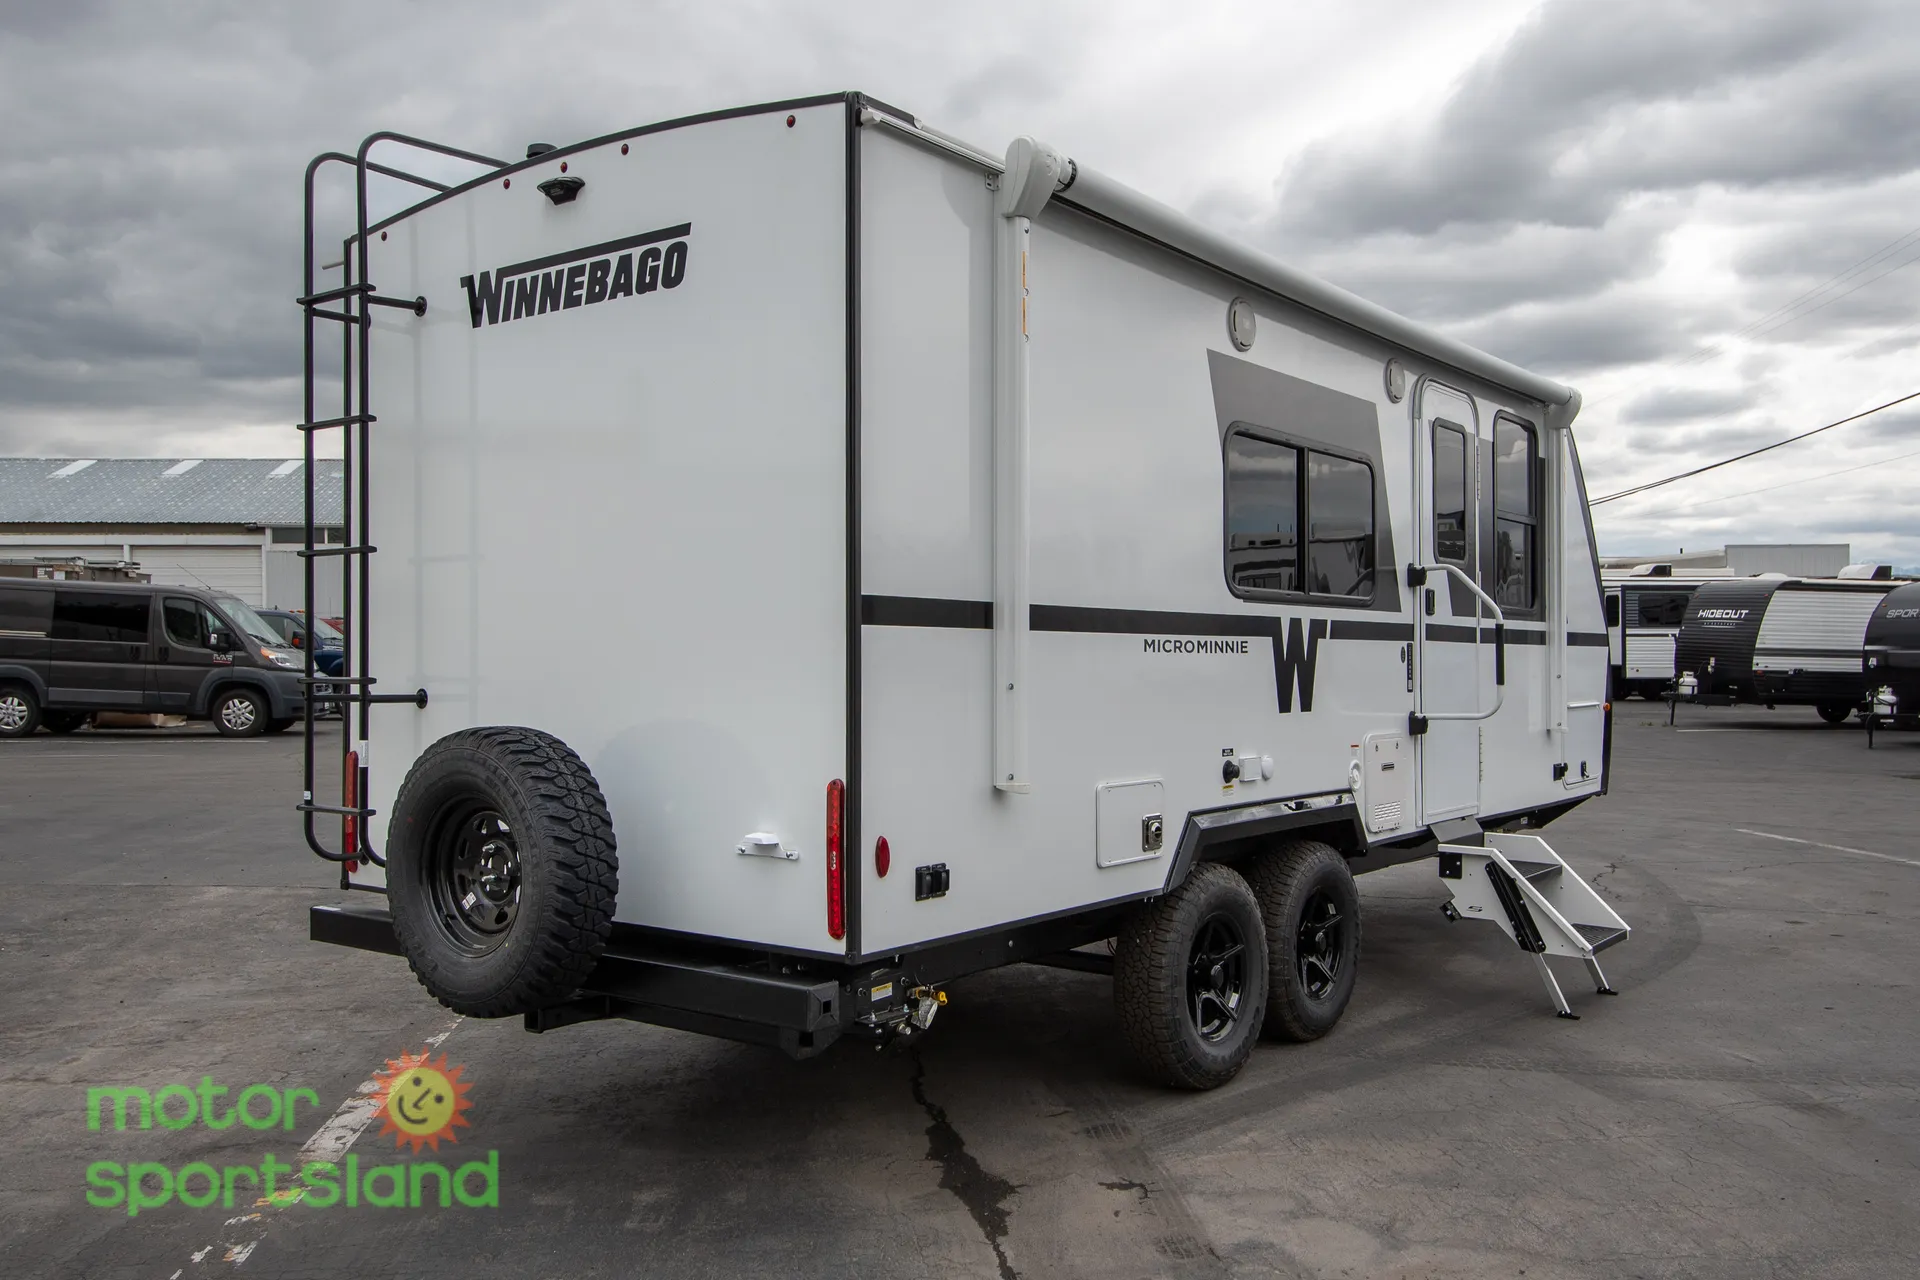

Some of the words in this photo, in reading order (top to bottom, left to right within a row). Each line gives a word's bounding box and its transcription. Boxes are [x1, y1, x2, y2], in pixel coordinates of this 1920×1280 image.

[460, 240, 689, 329] WINNEBAGO
[1697, 609, 1749, 618] HIDEOUT
[1886, 609, 1920, 618] SPOR
[1143, 639, 1249, 653] MICROMINNIE
[1271, 617, 1328, 714] W
